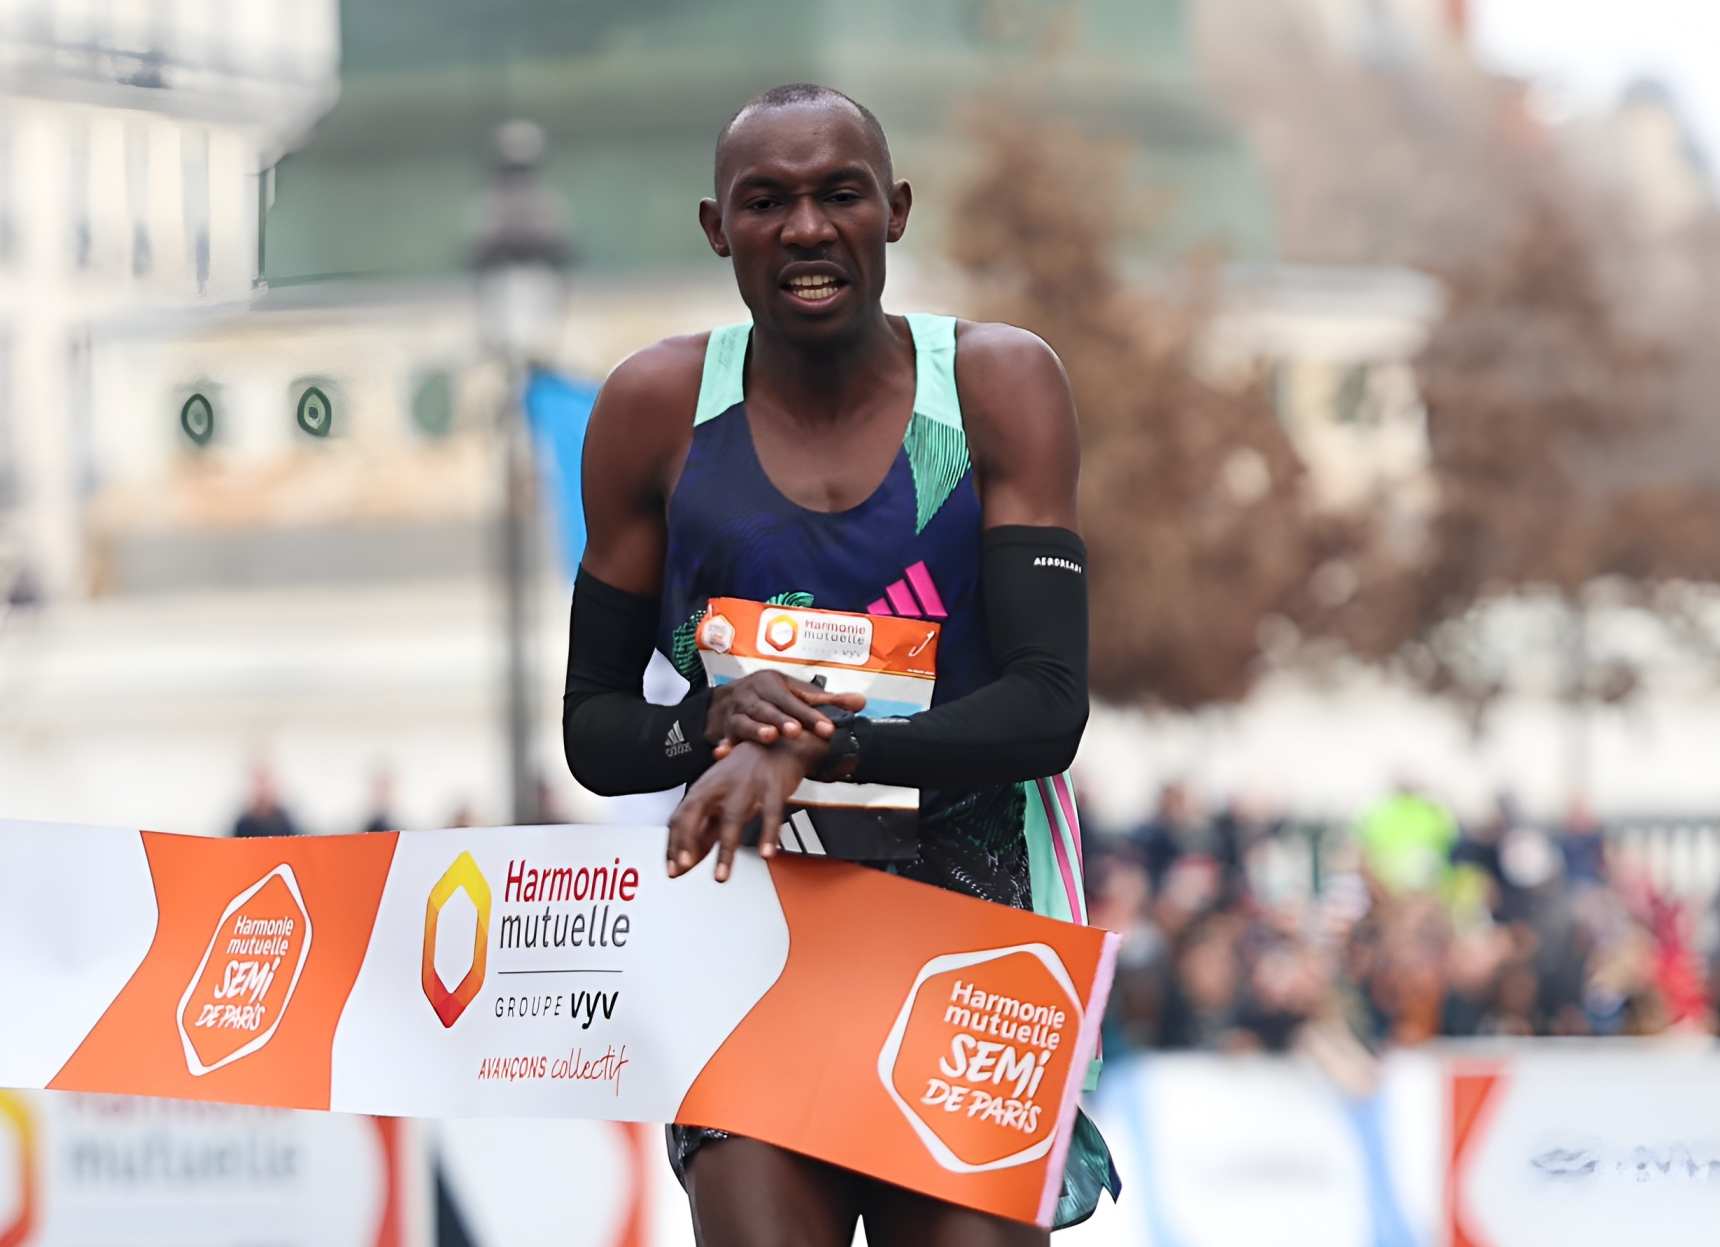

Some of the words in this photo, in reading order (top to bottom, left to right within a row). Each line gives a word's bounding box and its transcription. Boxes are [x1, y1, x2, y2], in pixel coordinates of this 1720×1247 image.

[805, 619, 866, 635] Harmonie
[504, 857, 640, 903] Harmonie
[234, 915, 294, 937] Harmonie
[499, 904, 631, 949] mutuelle
[226, 936, 289, 956] mutuelle
[194, 1003, 225, 1028] DE
[495, 995, 563, 1018] GROUPE
[950, 980, 1066, 1030] Harmonie
[944, 1005, 1060, 1050] mutuelle
[478, 1055, 547, 1082] AVANÇONS
[551, 1044, 629, 1097] collectif
[920, 1077, 971, 1112] DE
